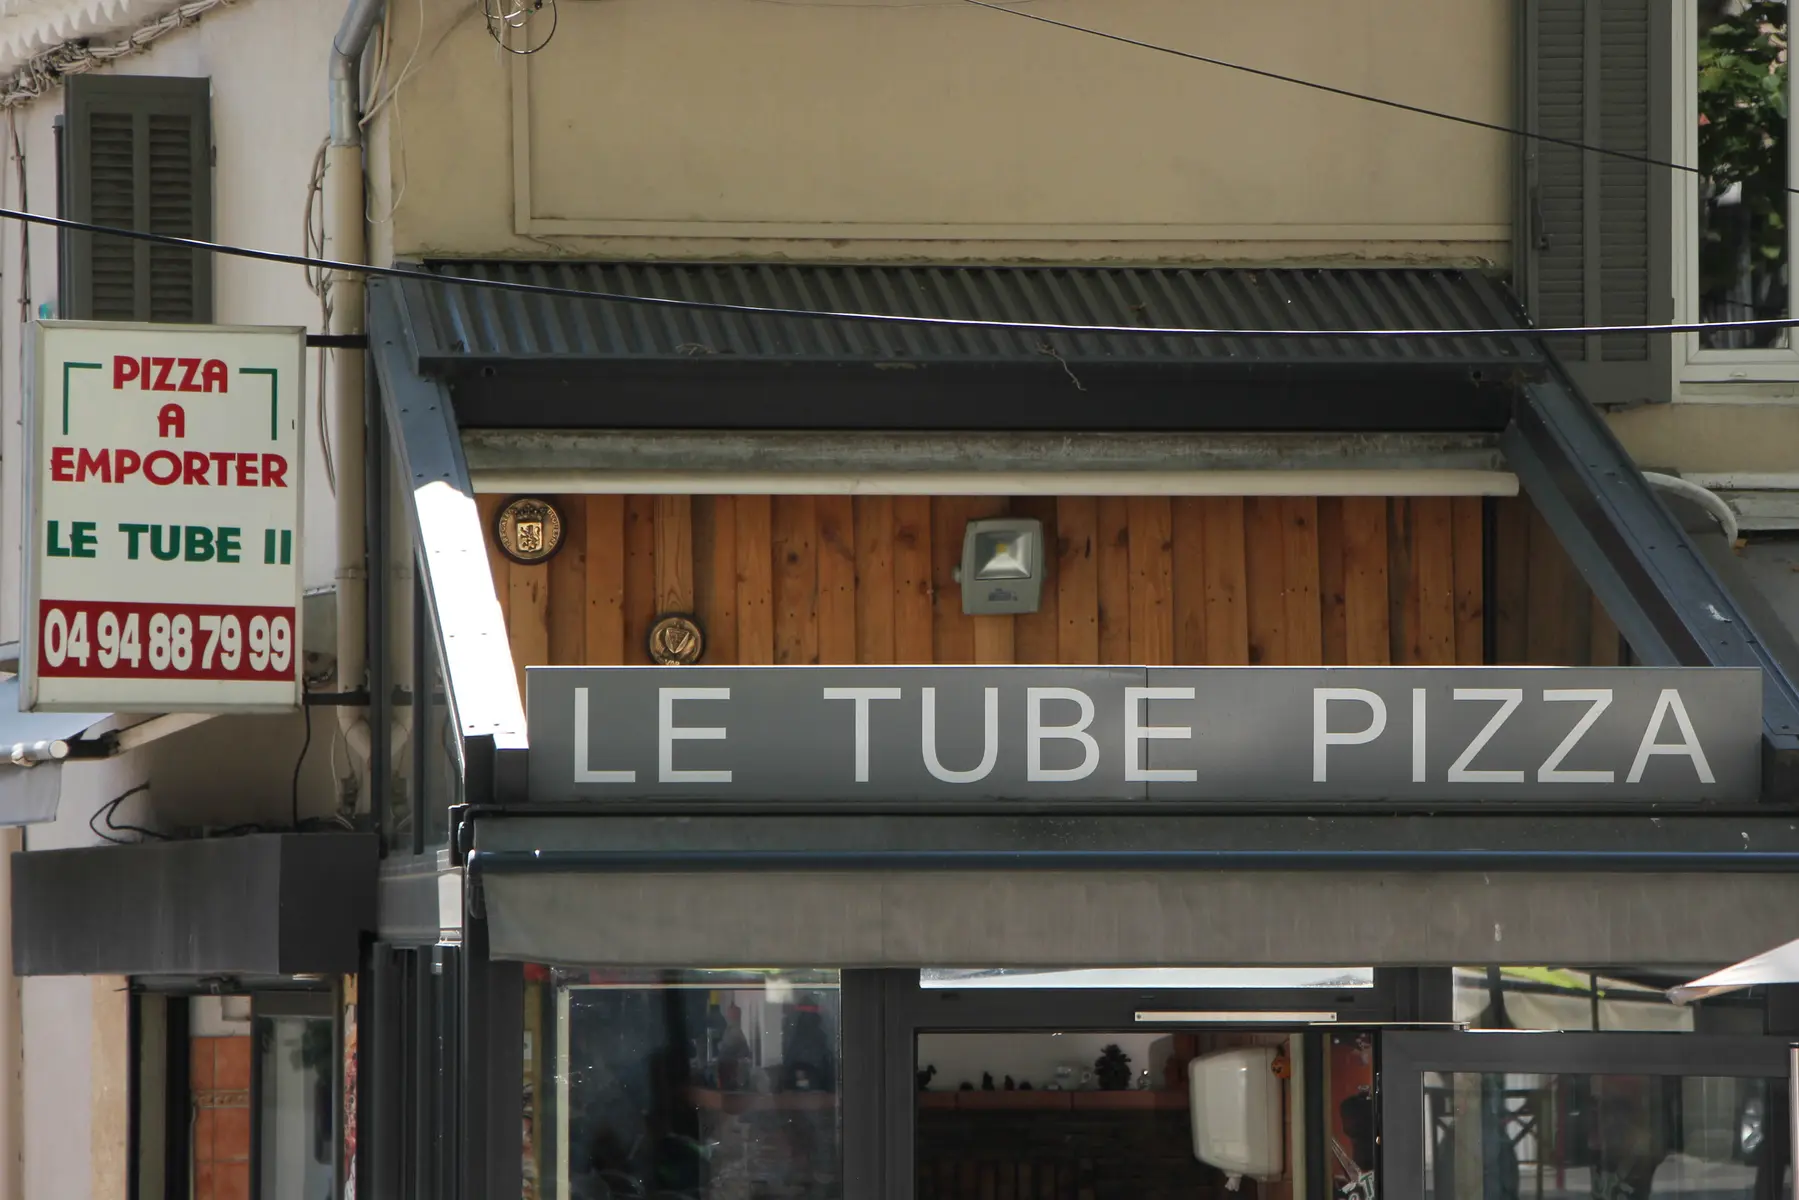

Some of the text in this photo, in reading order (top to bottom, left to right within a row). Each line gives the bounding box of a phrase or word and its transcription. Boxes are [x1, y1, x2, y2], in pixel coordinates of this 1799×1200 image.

[113, 355, 228, 393] PIZZA
[157, 403, 185, 438] A
[50, 447, 288, 488] EMPORTER
[47, 520, 292, 564] LE TUBE II
[44, 608, 291, 672] 04 94 88 79 99
[574, 687, 1717, 784] LE TUBE PIZZA
